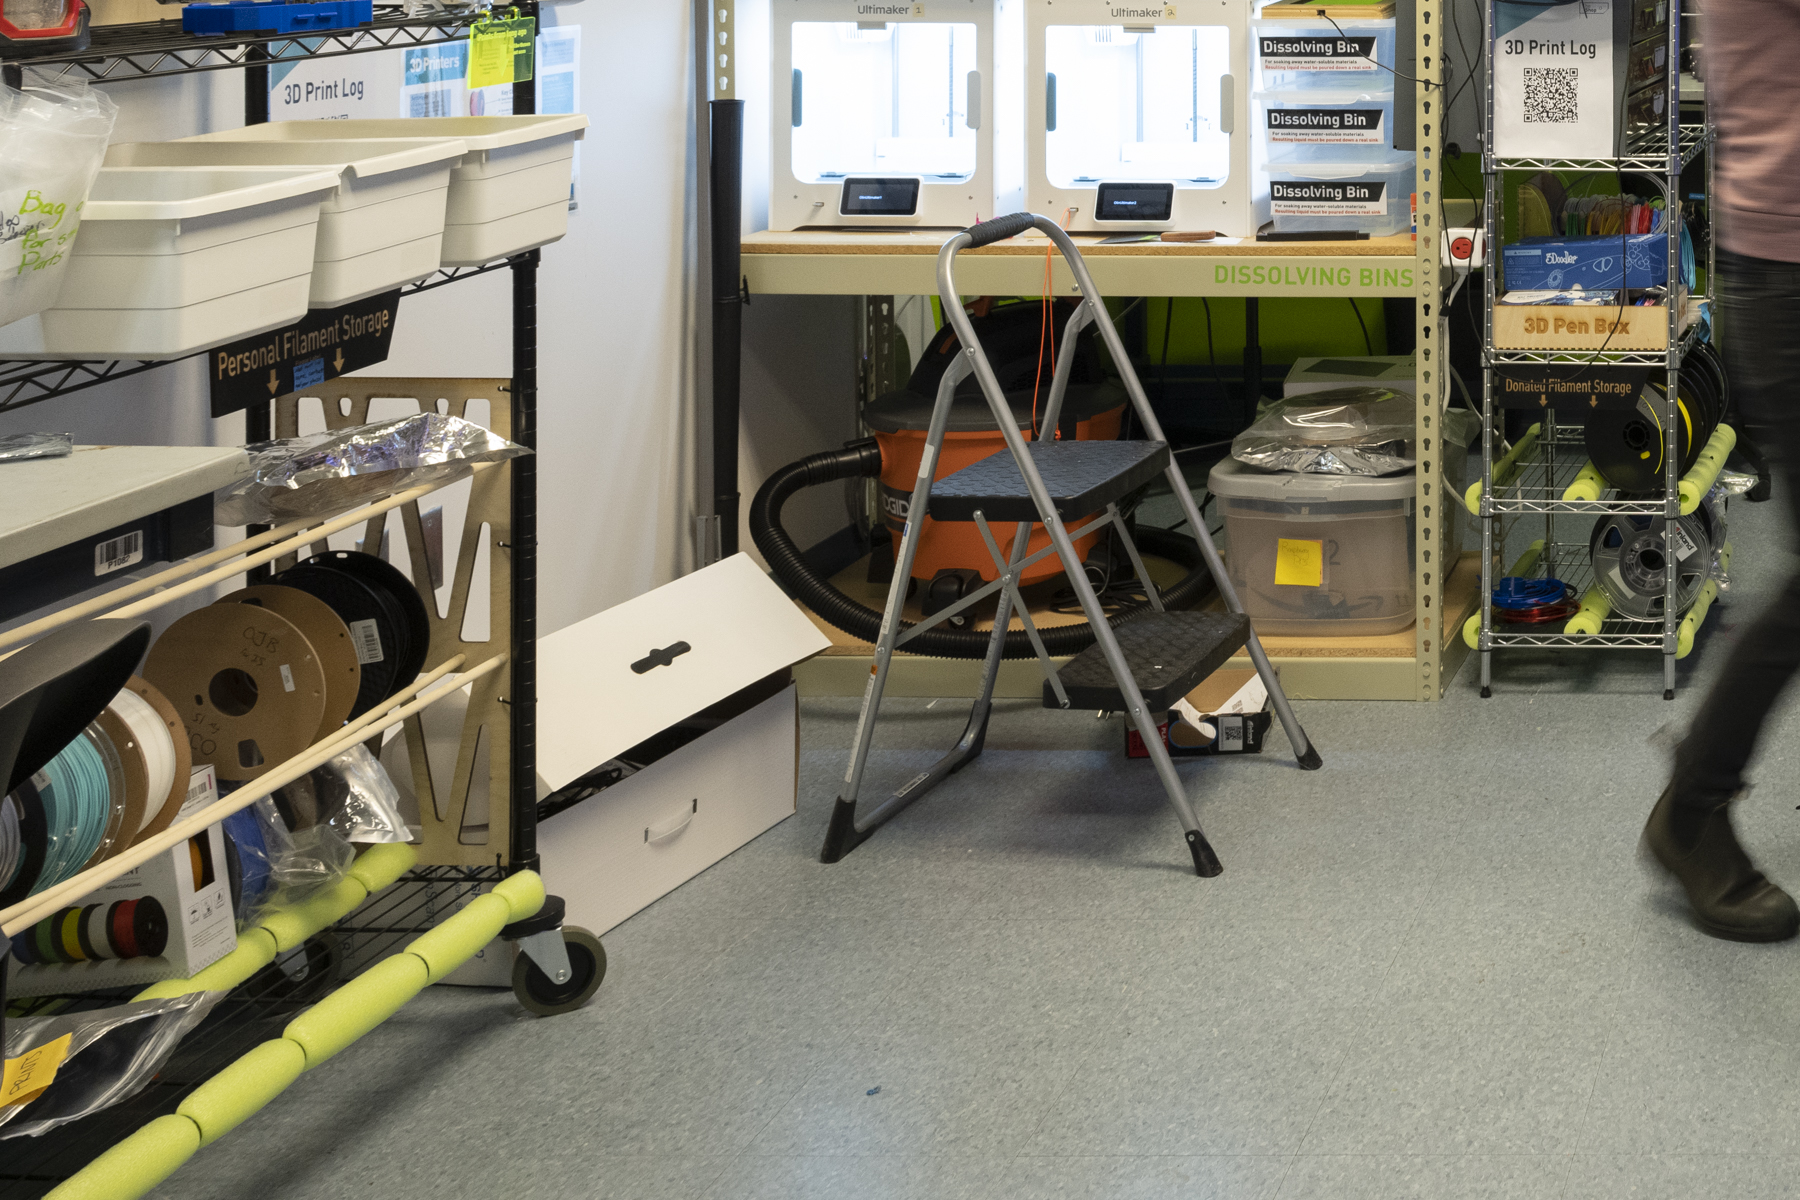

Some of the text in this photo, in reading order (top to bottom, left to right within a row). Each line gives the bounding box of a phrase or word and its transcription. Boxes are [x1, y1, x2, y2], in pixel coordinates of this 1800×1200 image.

[858, 5, 910, 14] Ultimaker
[1111, 8, 1163, 17] Ultimaker
[1263, 41, 1360, 55] Dissolving Bin
[1505, 39, 1597, 59] 3D Print Log
[409, 56, 460, 73] 3D Printers
[284, 78, 364, 104] 3D Print Log
[1271, 112, 1366, 128] Dissolving Bin
[1274, 185, 1369, 200] Dissolving Bin
[19, 190, 66, 230] Bag
[1214, 264, 1414, 288] DISSOLVING BINS
[1524, 318, 1630, 334] 3D Pen Box
[218, 349, 279, 380] Personal
[284, 320, 339, 362] Filament
[343, 309, 389, 341] Storage
[1505, 379, 1632, 396] Donated Filament Storage
[1677, 531, 1694, 551] inland
[107, 554, 130, 570] P1082
